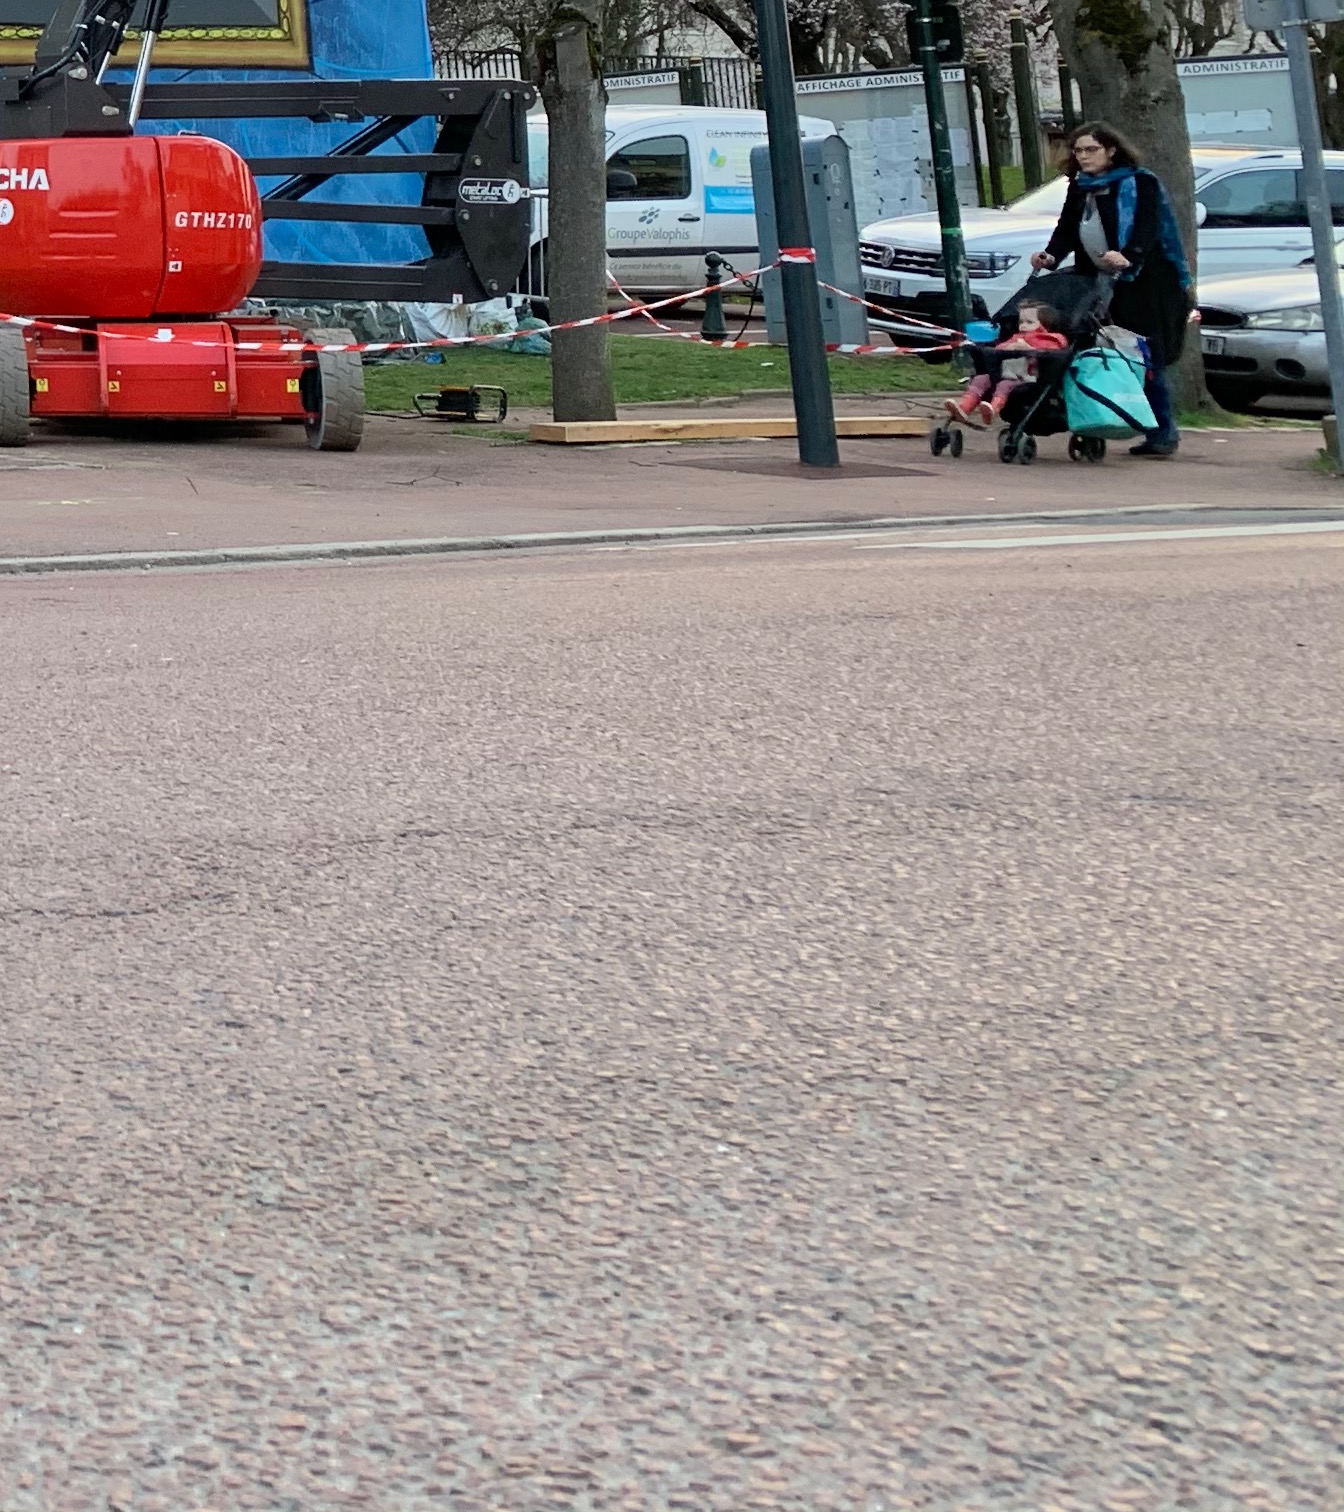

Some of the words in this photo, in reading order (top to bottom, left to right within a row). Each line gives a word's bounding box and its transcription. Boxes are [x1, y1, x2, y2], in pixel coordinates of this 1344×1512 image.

[1183, 59, 1286, 74] ADMINISTRATIF
[797, 78, 862, 92] AFFICHAGE
[866, 70, 961, 87] ADMINISTIF
[175, 211, 252, 229] GTHZ170
